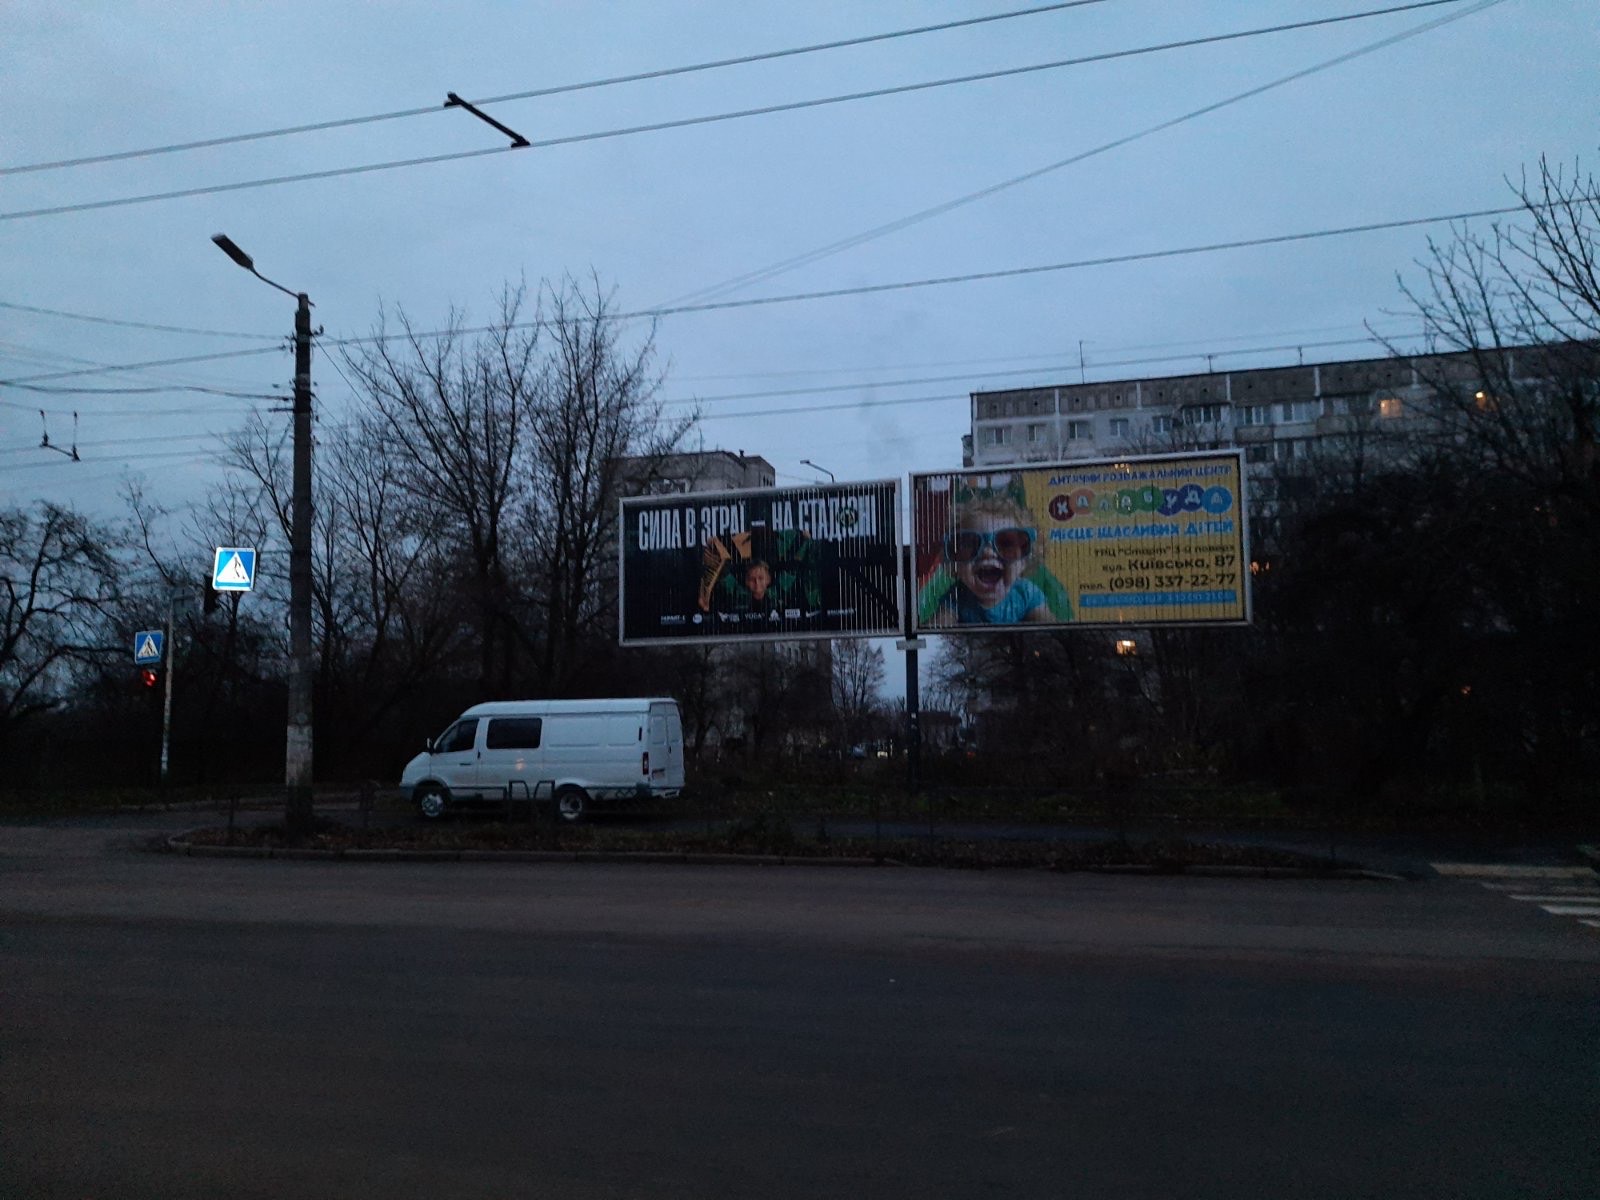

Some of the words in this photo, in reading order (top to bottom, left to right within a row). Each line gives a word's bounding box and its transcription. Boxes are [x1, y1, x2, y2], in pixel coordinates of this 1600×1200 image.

[1195, 464, 1232, 477] ЦЕНТР
[639, 509, 682, 551] СИЛА
[686, 507, 697, 548] В
[701, 500, 746, 547] ЗГРАЇ
[772, 500, 794, 532] НА
[1097, 523, 1179, 540] ЩАСЛИВИХ
[1184, 519, 1233, 536] ДІТЕЙ
[1128, 557, 1210, 571] Київська,
[1214, 555, 1235, 568] 87
[1109, 576, 1150, 591] (098)
[1155, 573, 1236, 588] 337-22-77
